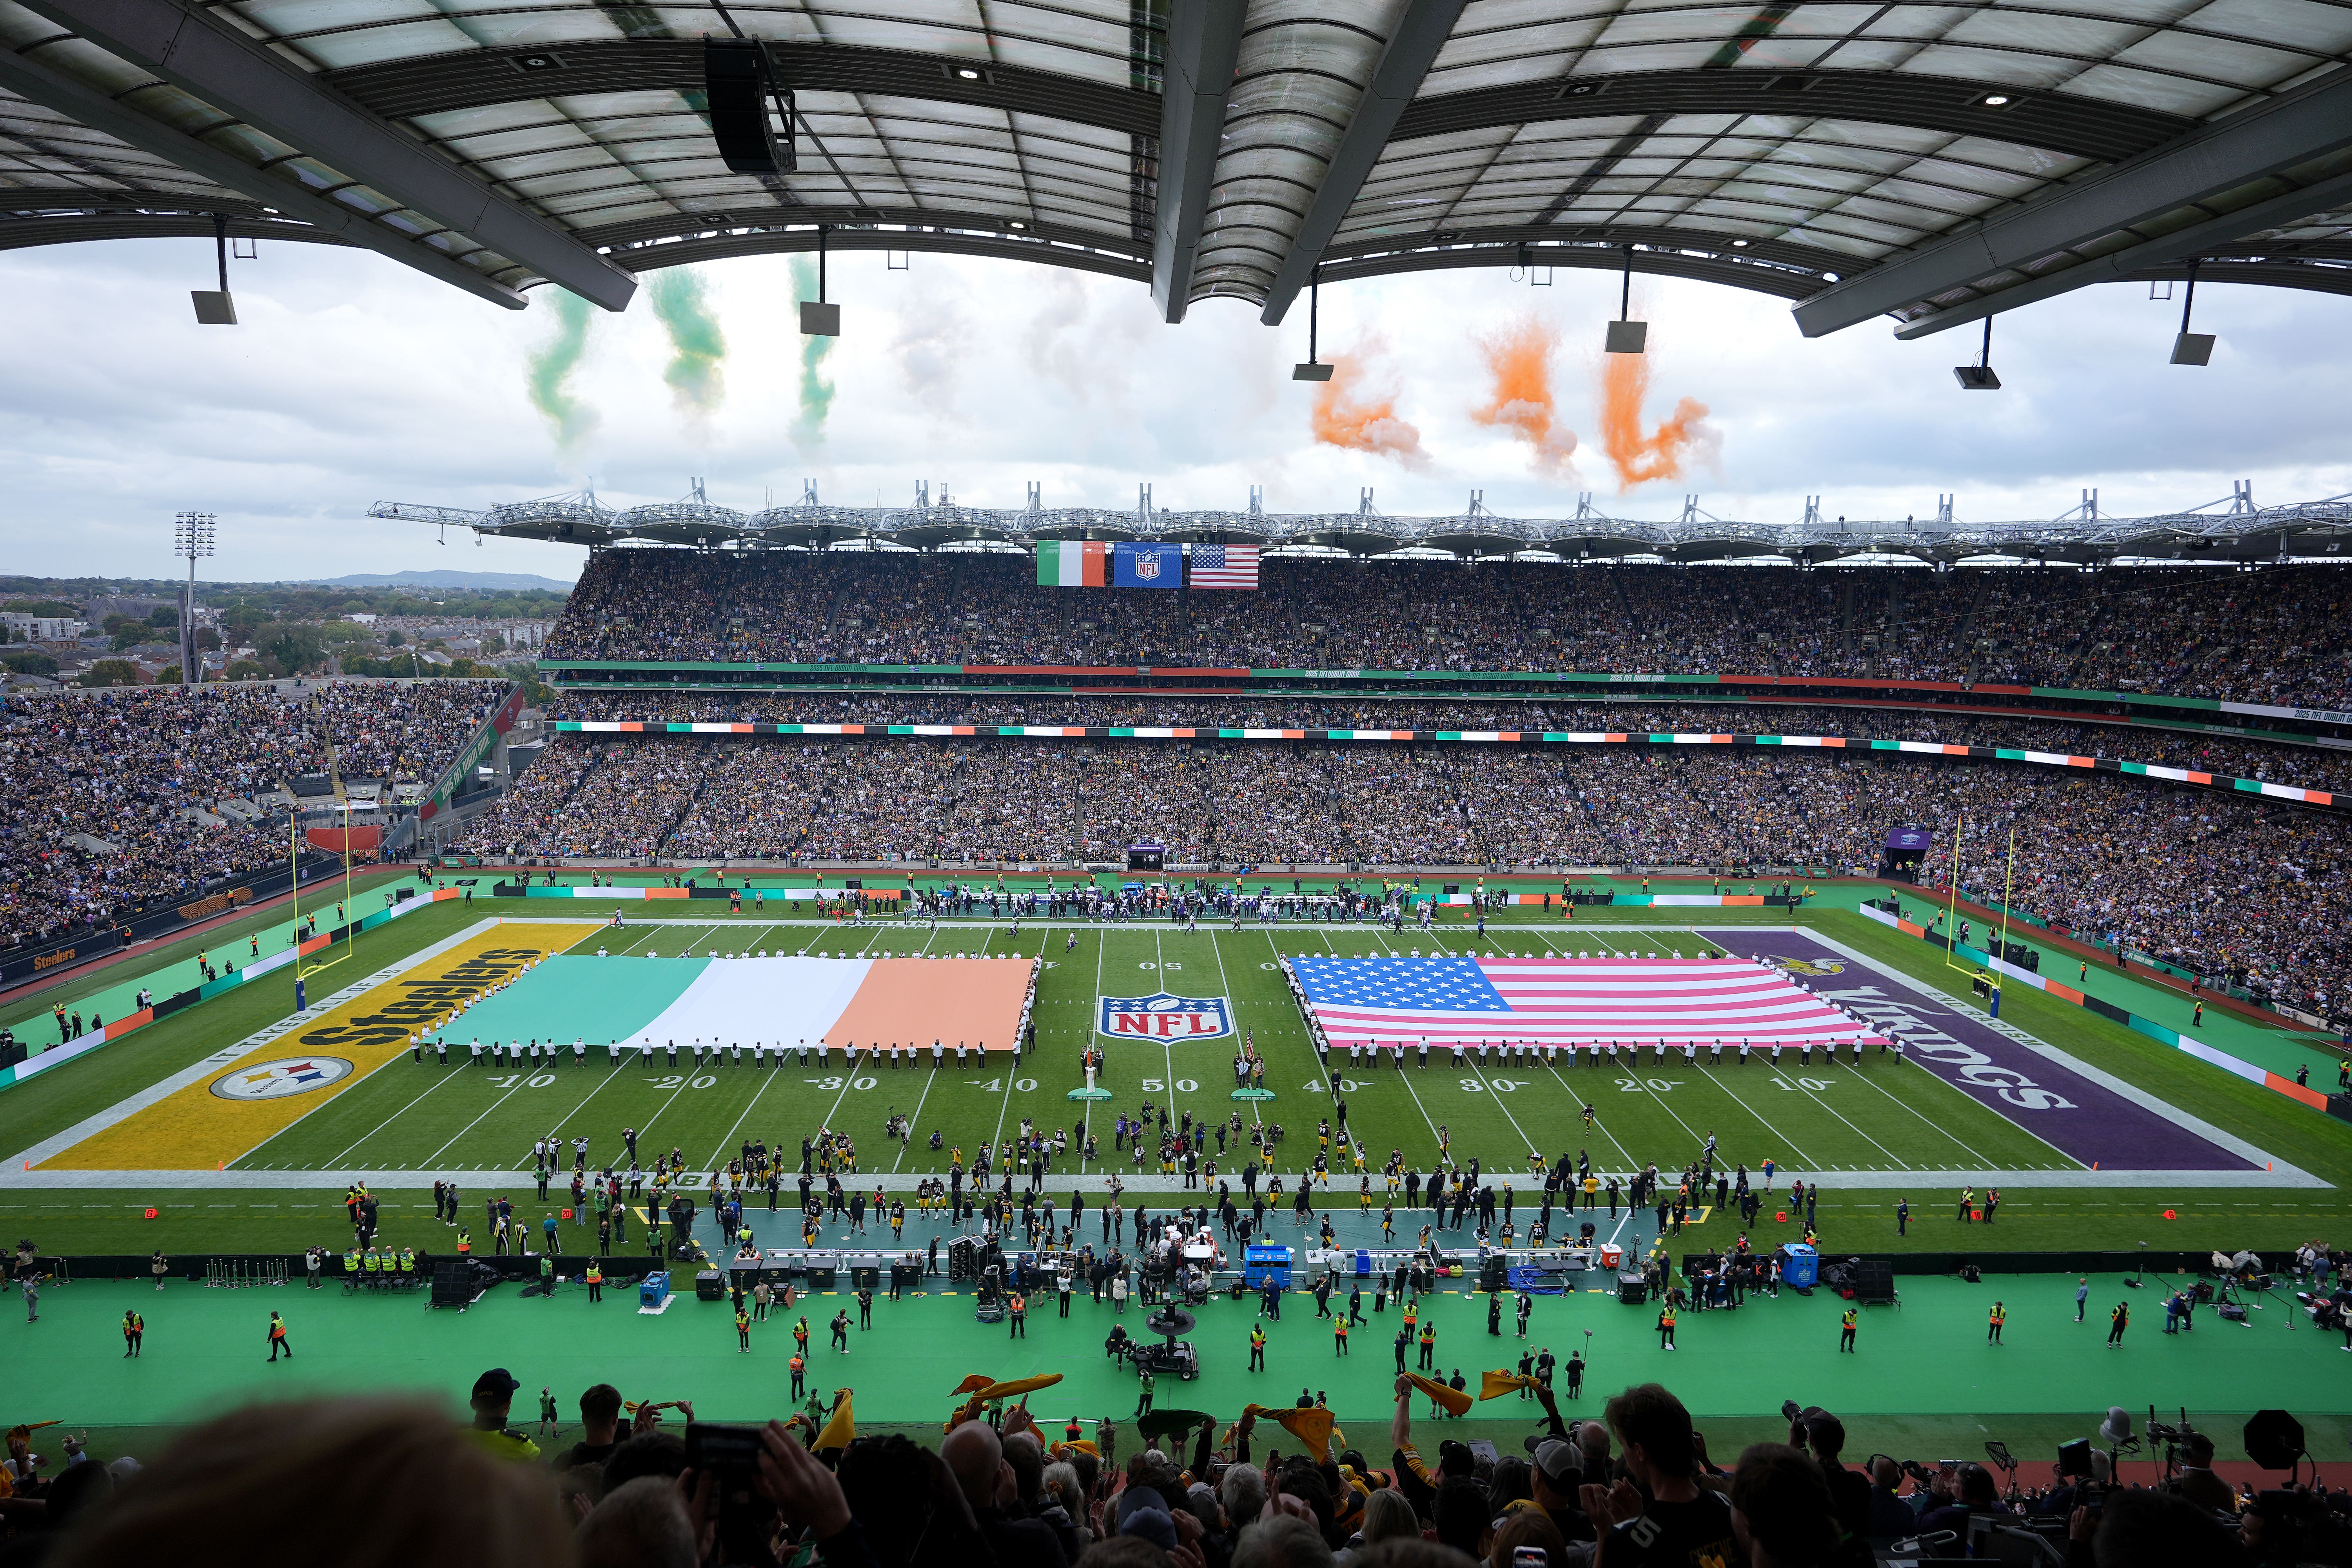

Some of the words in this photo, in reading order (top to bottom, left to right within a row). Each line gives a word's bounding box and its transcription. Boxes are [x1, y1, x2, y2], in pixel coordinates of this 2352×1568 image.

[1139, 563, 1158, 576] NFL
[2294, 710, 2310, 718] 2025
[2311, 711, 2322, 719] NFL
[2324, 712, 2345, 722] DUBLIN
[441, 777, 454, 800] 2025
[453, 767, 463, 785] NFL
[462, 747, 478, 774] DUBLIN
[477, 732, 490, 755] GAME
[34, 949, 75, 970] Steelers
[1139, 962, 1182, 971] 50
[299, 949, 541, 1046] Steelers
[207, 1053, 240, 1062] IT
[236, 1016, 312, 1047] TAKES
[309, 996, 352, 1011] ALL
[347, 982, 372, 992] OF
[370, 969, 401, 979] US
[1924, 992, 1966, 1007] END
[1962, 1011, 2046, 1046] RACISM
[1114, 1014, 1217, 1037] NFL
[250, 1079, 283, 1094] Steelers
[495, 1074, 556, 1088] 10
[653, 1076, 717, 1089] 20
[818, 1077, 878, 1090] 30
[980, 1078, 1038, 1091] 40
[1142, 1079, 1198, 1092] 50
[1303, 1079, 1358, 1092] 40
[1459, 1079, 1517, 1092] 30
[1614, 1079, 1673, 1091] 20
[1769, 1078, 1826, 1091] 10
[1534, 1227, 1542, 1236] 25
[1756, 1265, 1762, 1276] K
[1630, 1515, 1662, 1548] 5
